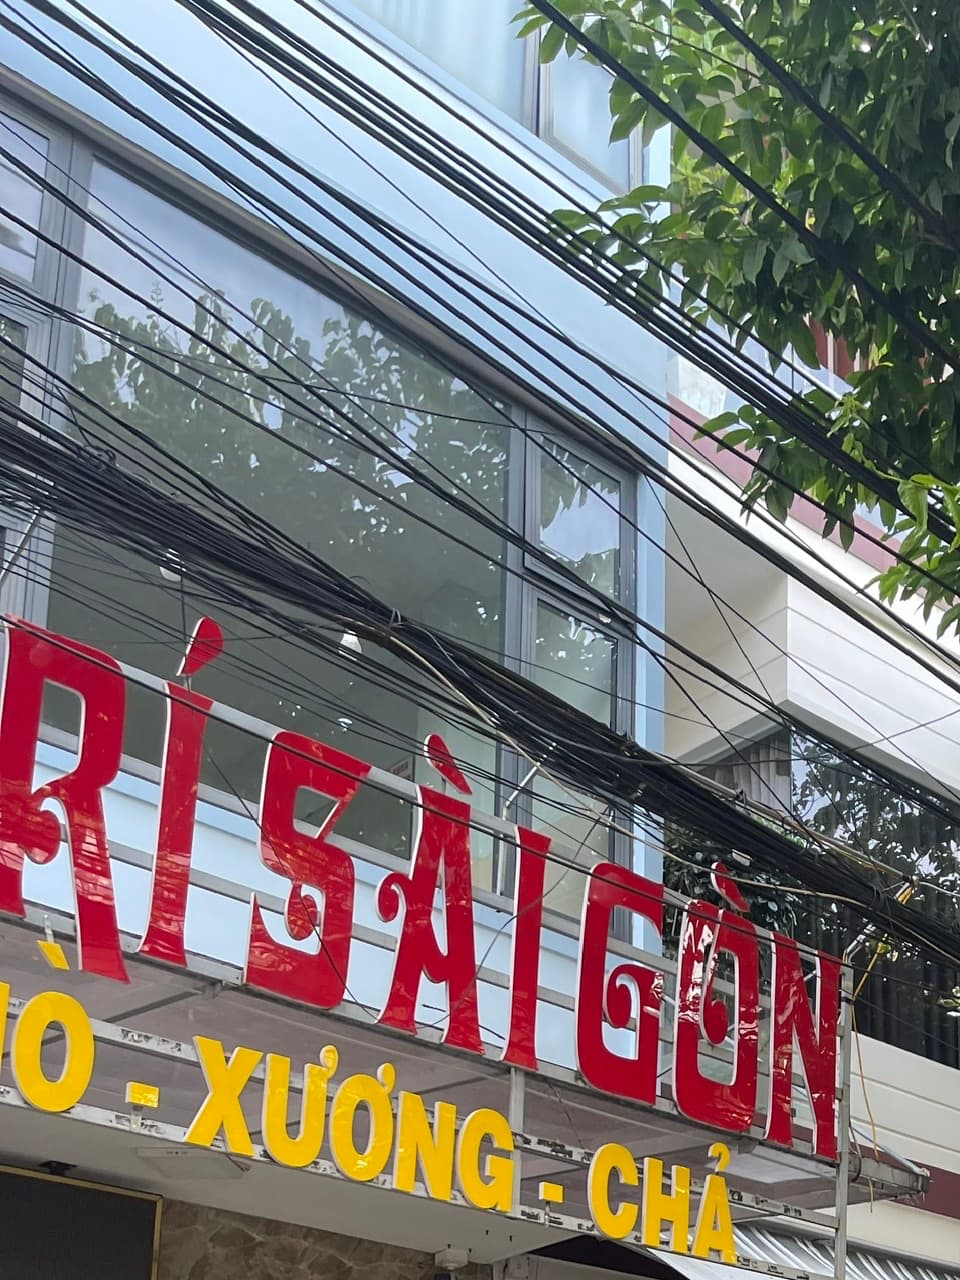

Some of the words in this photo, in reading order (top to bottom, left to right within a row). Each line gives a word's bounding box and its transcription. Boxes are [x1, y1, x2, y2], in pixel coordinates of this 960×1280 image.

[243, 732, 551, 1070] SÀI
[577, 861, 847, 1158] GÒN
[186, 1036, 515, 1214] XƯƠNG
[588, 1142, 738, 1264] CHẢ
